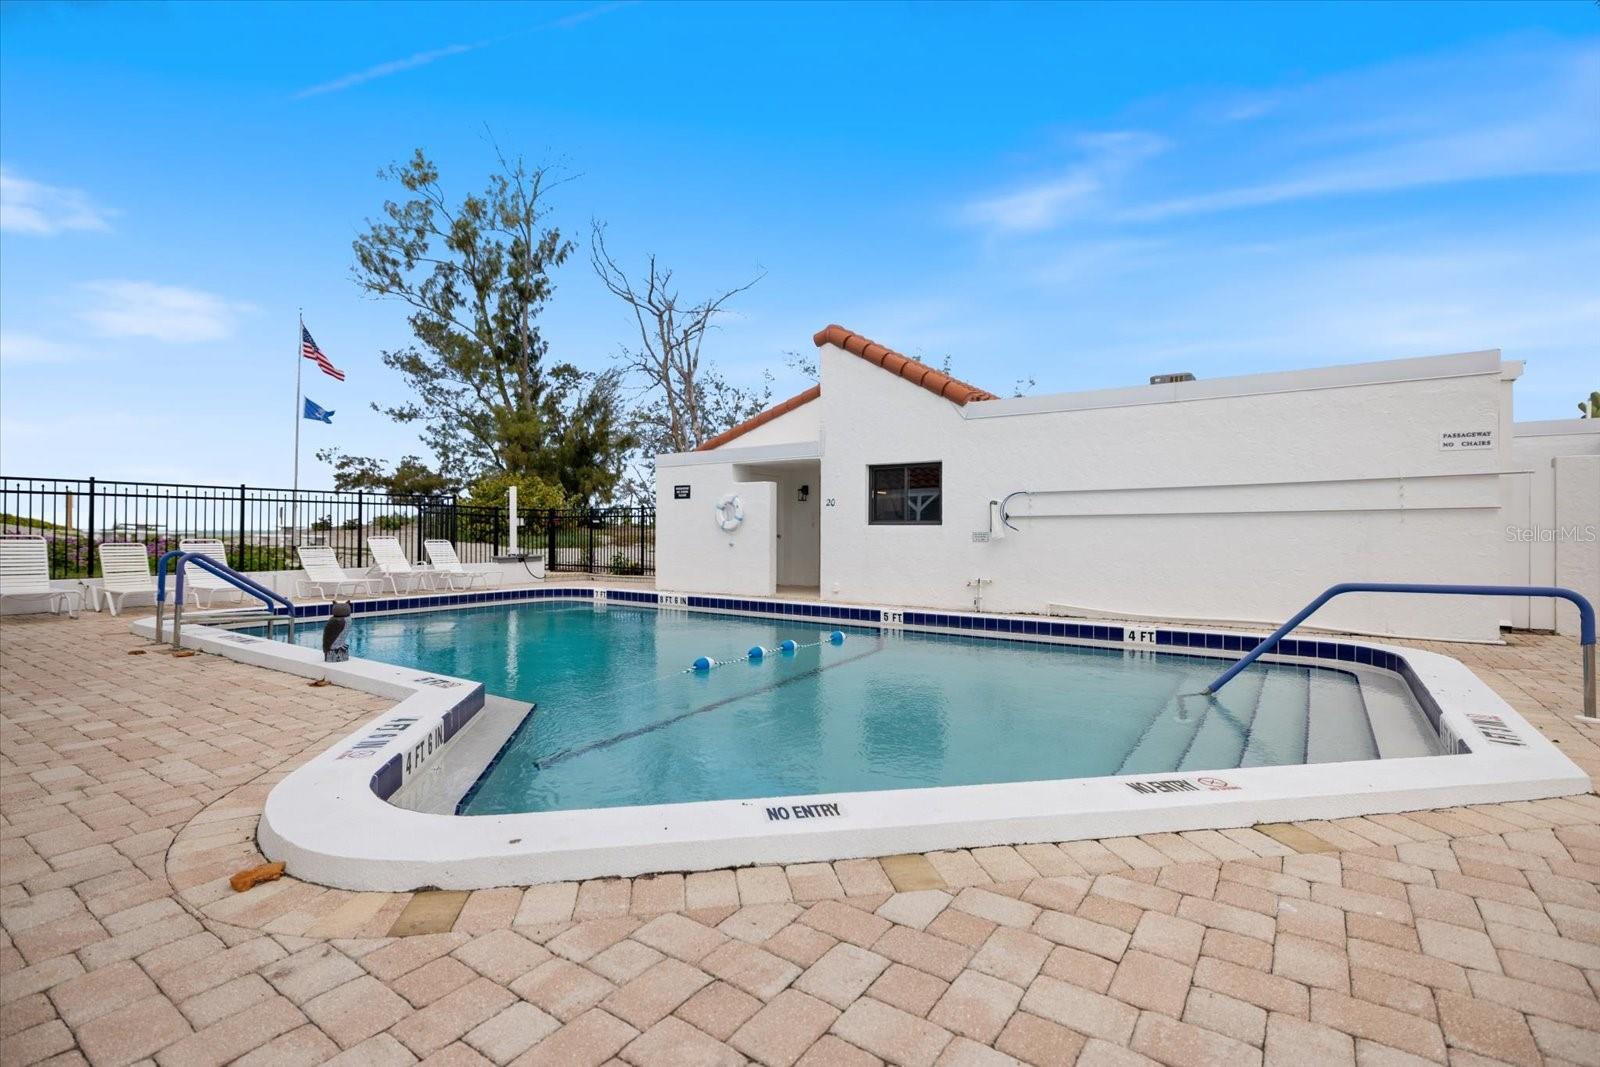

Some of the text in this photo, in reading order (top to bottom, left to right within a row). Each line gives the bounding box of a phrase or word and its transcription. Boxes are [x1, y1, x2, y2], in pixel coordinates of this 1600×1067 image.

[1443, 431, 1491, 439] PASSAGEWAY
[825, 498, 836, 507] 20
[883, 611, 889, 622] 5
[1128, 630, 1136, 641] 4
[406, 751, 412, 775] 4
[427, 732, 433, 756] 6
[1125, 779, 1200, 795] NO ENTRY
[766, 803, 841, 821] NO ENTRY
